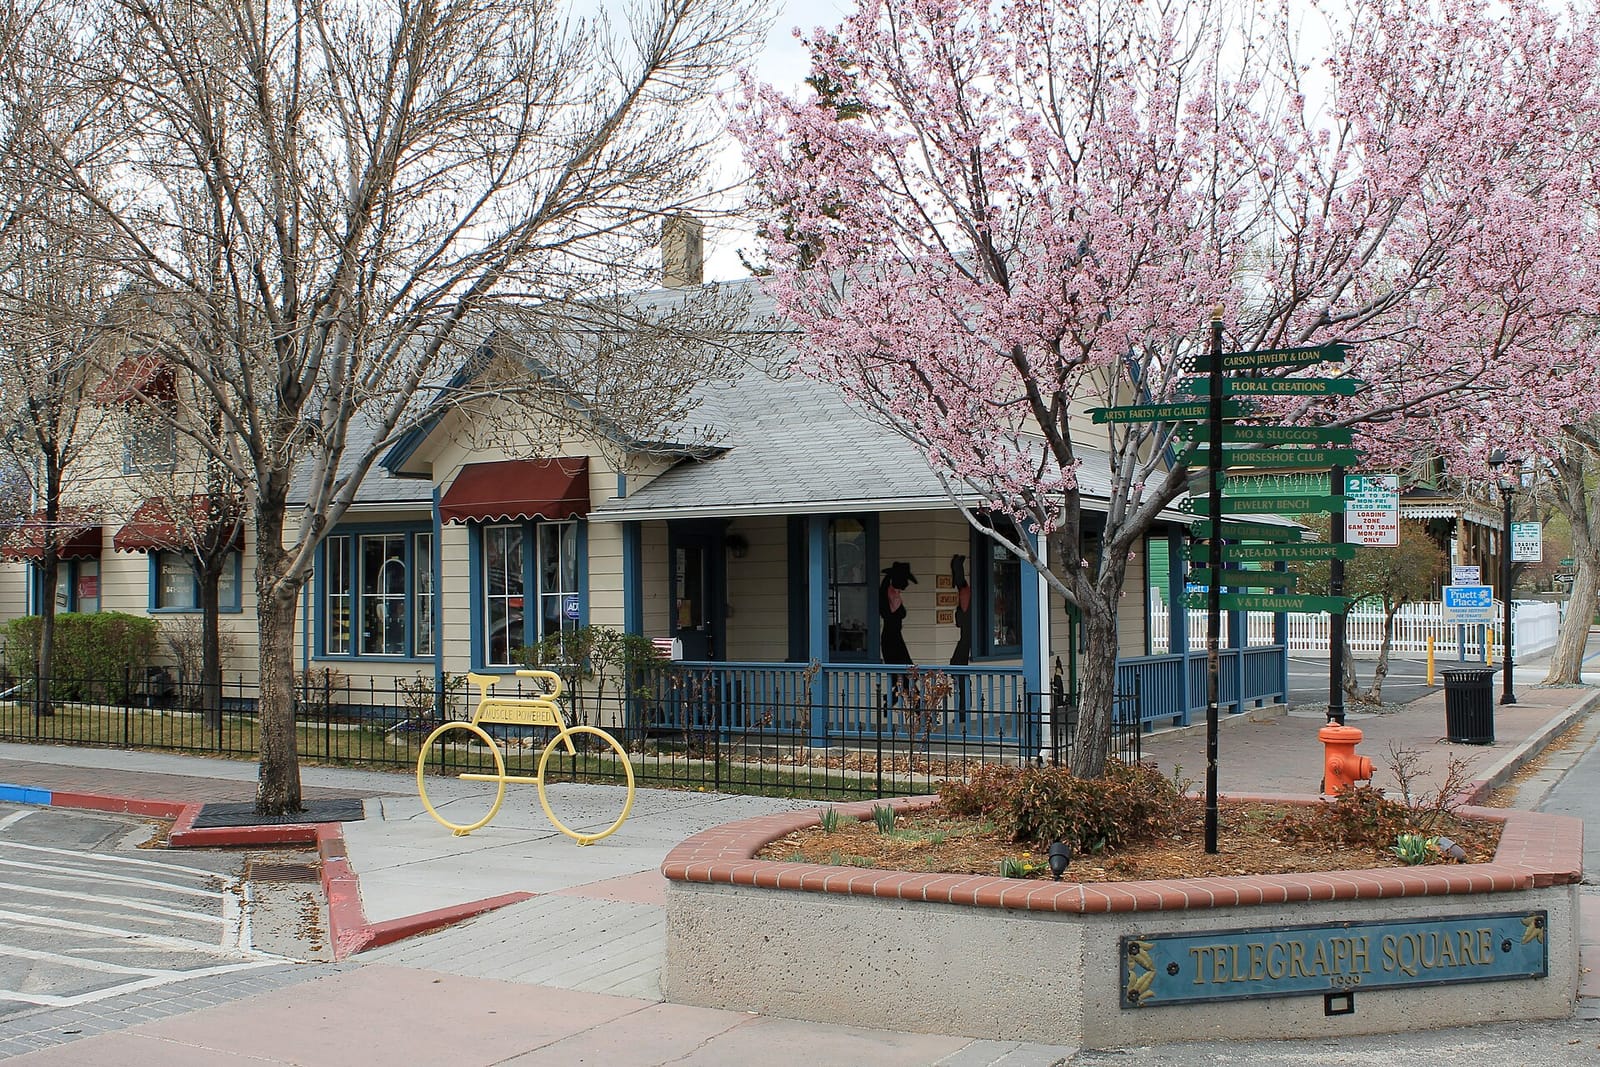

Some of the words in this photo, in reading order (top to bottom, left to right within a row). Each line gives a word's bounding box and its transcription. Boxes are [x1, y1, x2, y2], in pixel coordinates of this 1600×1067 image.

[1223, 355, 1255, 366] CARSON
[1256, 353, 1288, 365] JEWELRY
[1298, 351, 1320, 360] LOAN
[1231, 382, 1268, 391] FLORAL
[1271, 382, 1326, 392] CREATIONS
[1103, 411, 1126, 420] ARTSY
[1129, 409, 1156, 418] FARTSY
[1158, 408, 1172, 417] ART
[1174, 406, 1207, 416] GALLERY
[1235, 430, 1254, 439] MO
[1256, 430, 1264, 439] &
[1267, 430, 1318, 439] SLUGGO'S
[1232, 453, 1295, 462] HORSESHOE
[1297, 453, 1324, 462] CLUB
[1350, 480, 1360, 490] 2
[1234, 500, 1276, 510] JEWELRY
[1277, 500, 1310, 508] BENCH
[1281, 548, 1297, 556] TEA
[1300, 548, 1336, 556] SHOPPE
[567, 602, 580, 611] AD
[1262, 599, 1304, 608] RAILWAY
[486, 708, 512, 720] MUSCLE
[516, 710, 551, 722] POWERED
[1189, 937, 1371, 985] TELEGRAPH
[1382, 928, 1494, 977] SQUARE
